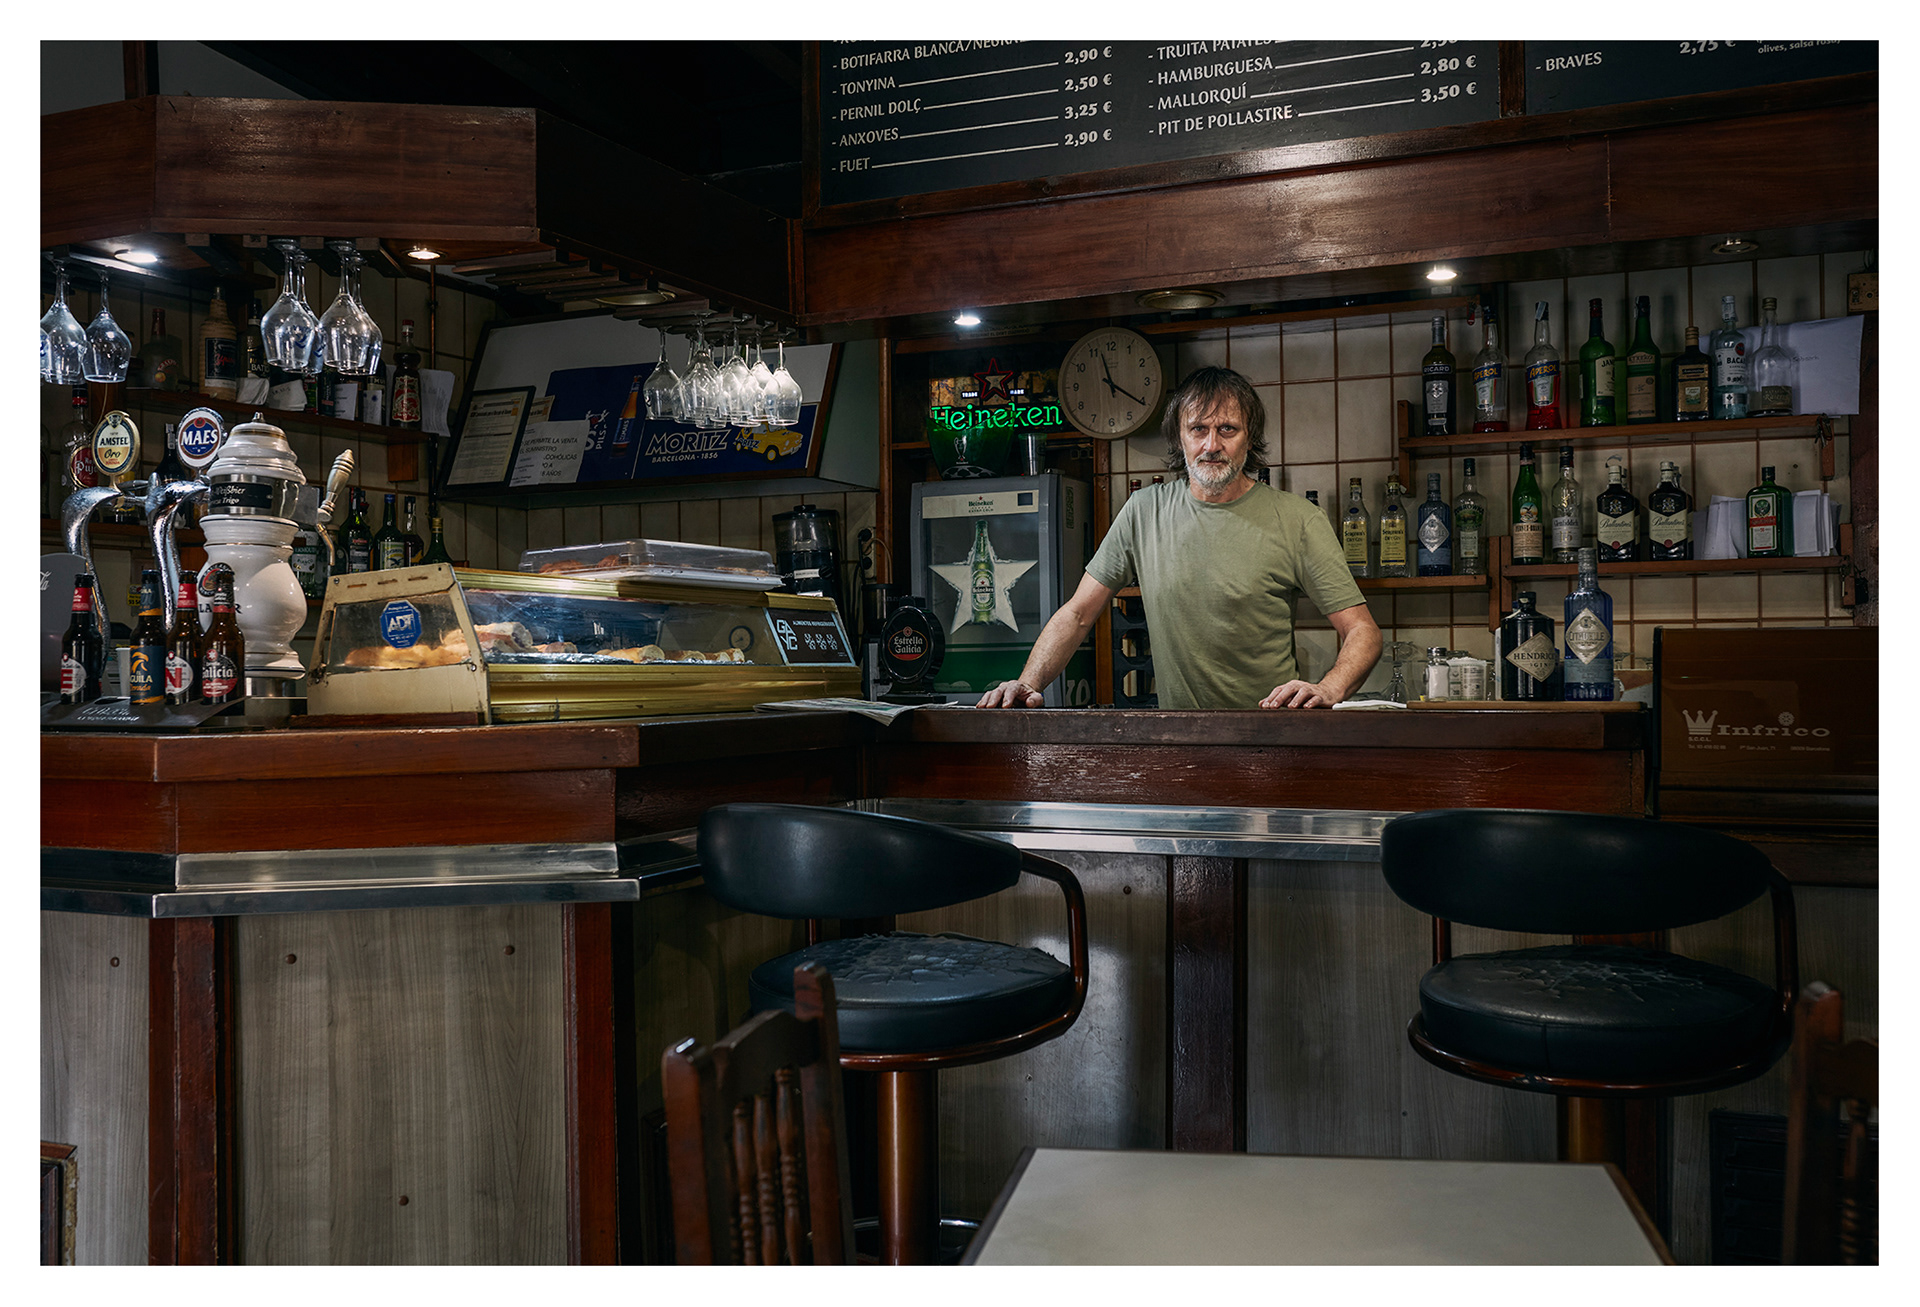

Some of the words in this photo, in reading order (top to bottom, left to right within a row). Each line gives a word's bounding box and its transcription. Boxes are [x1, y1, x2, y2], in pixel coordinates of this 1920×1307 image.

[1157, 43, 1208, 61] TRUITA
[1679, 40, 1719, 55] 2,75
[1757, 44, 1787, 54] olives,
[1789, 40, 1813, 50] salsa
[840, 48, 910, 71] BOTIFARRA
[1544, 51, 1603, 72] BRAVES
[840, 76, 896, 95] TONYINA
[1064, 48, 1099, 64] 2,90
[1157, 56, 1274, 85] HAMBURGUESA
[1157, 82, 1247, 111] MALLORQUÍ
[1420, 58, 1460, 76] 2,80
[840, 104, 884, 121] PERNIL
[888, 98, 922, 115] DOLÇ
[1064, 75, 1099, 92] 2,50
[1158, 120, 1180, 136] PIT
[1184, 117, 1204, 132] DE
[1207, 104, 1293, 129] POLLASTRE
[1420, 84, 1460, 103] 3,50
[839, 127, 900, 148] ANXOVES
[1064, 102, 1099, 119] 3,25
[839, 157, 871, 173] FUET
[1064, 130, 1099, 147] 2,90
[1090, 348, 1098, 358] 11
[1106, 341, 1116, 351] 12
[1076, 362, 1086, 372] 10
[1138, 358, 1145, 367] 2
[1423, 365, 1450, 373] RICARD
[1529, 364, 1557, 378] APEROL
[1072, 383, 1080, 392] 9
[1143, 377, 1151, 387] 3
[1077, 401, 1085, 410] 8
[931, 402, 1063, 430] Heineken
[1090, 414, 1097, 423] 7
[1108, 417, 1116, 427] 6
[1126, 411, 1133, 421] 5
[100, 437, 129, 446] AMSTEL
[181, 429, 219, 446] MAES
[595, 431, 607, 450] PILS
[644, 429, 731, 456] MORITZ
[104, 449, 121, 459] Oro
[651, 454, 696, 464] BARCELONA
[700, 451, 718, 461] 1856
[222, 496, 240, 505] Trigo
[388, 614, 415, 633] ADT
[894, 636, 923, 646] Estrella
[894, 645, 922, 654] Galicia
[1717, 719, 1831, 737] Infrico
